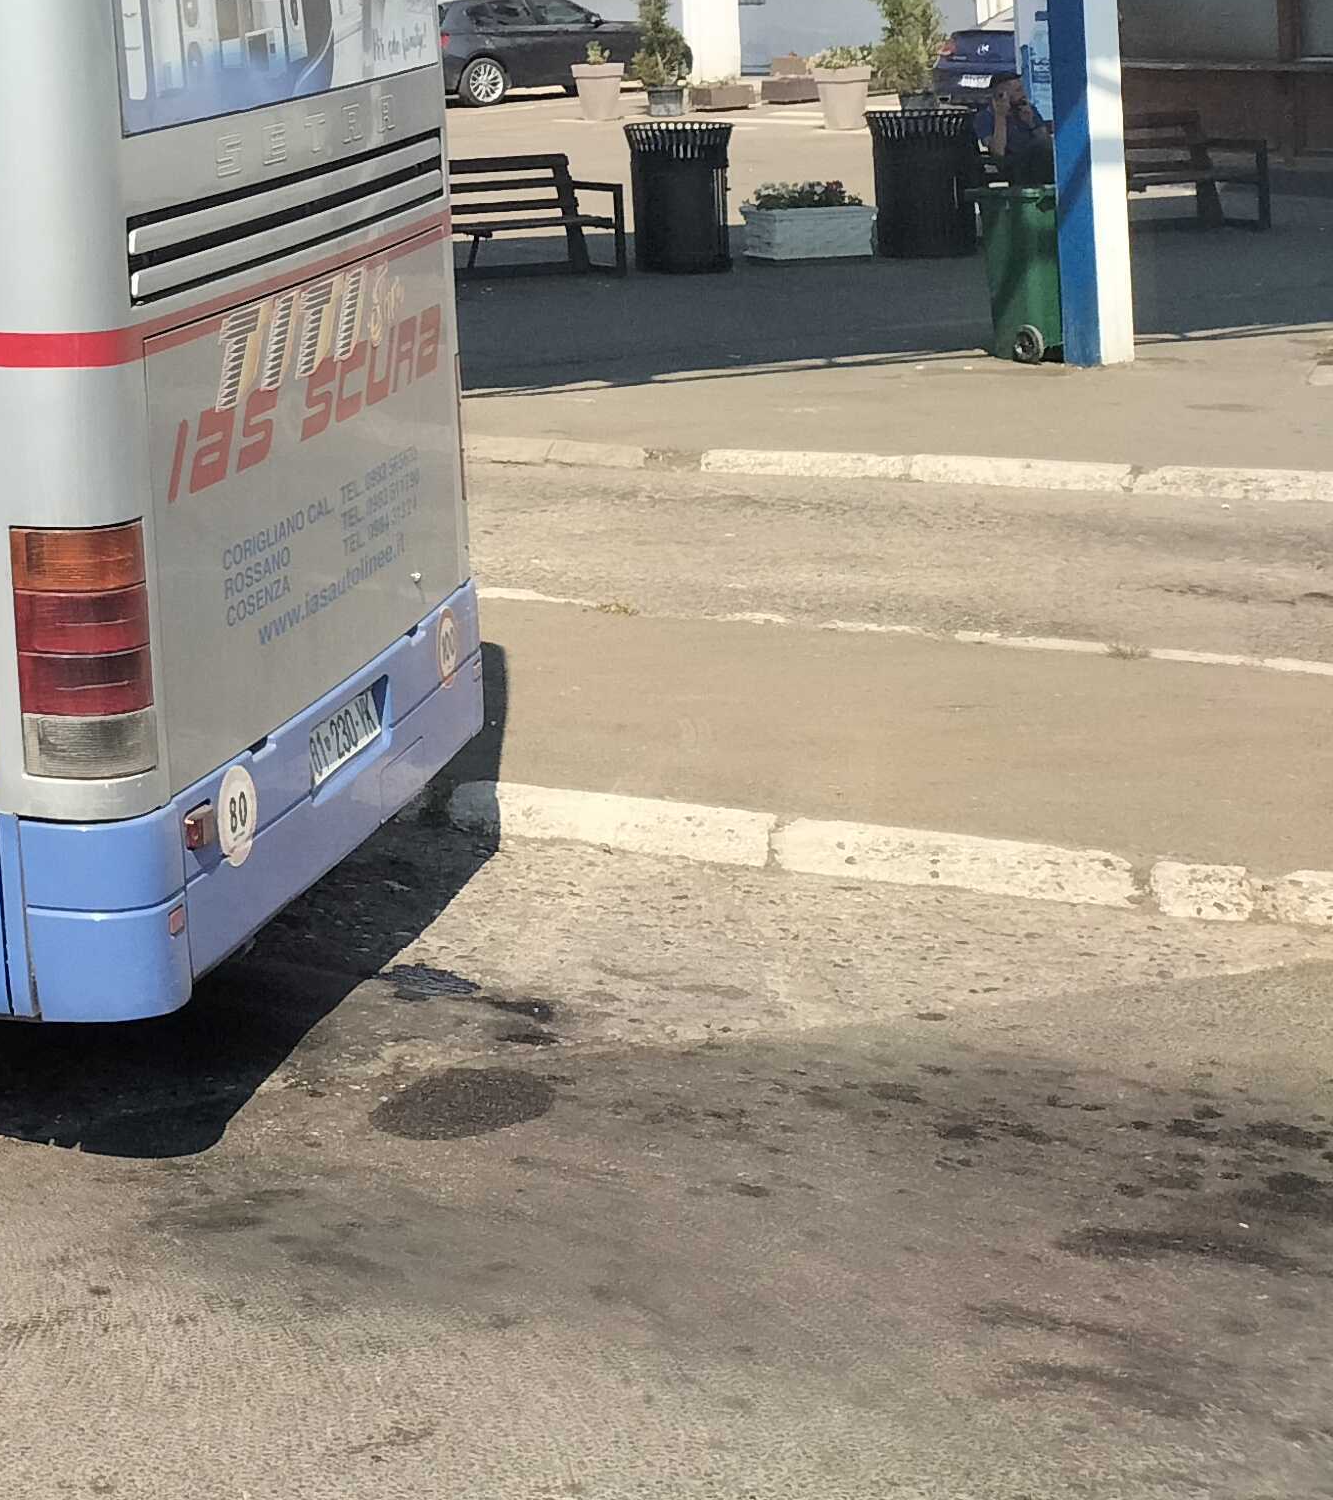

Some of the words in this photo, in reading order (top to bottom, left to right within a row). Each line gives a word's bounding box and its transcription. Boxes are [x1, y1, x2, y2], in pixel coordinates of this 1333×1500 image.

[223, 510, 305, 571] CORIGLIANO
[224, 546, 291, 599] ROSSANO
[258, 532, 405, 646] www.iasautolinee.it
[226, 574, 292, 627] COSENZA
[229, 791, 248, 833] 80
